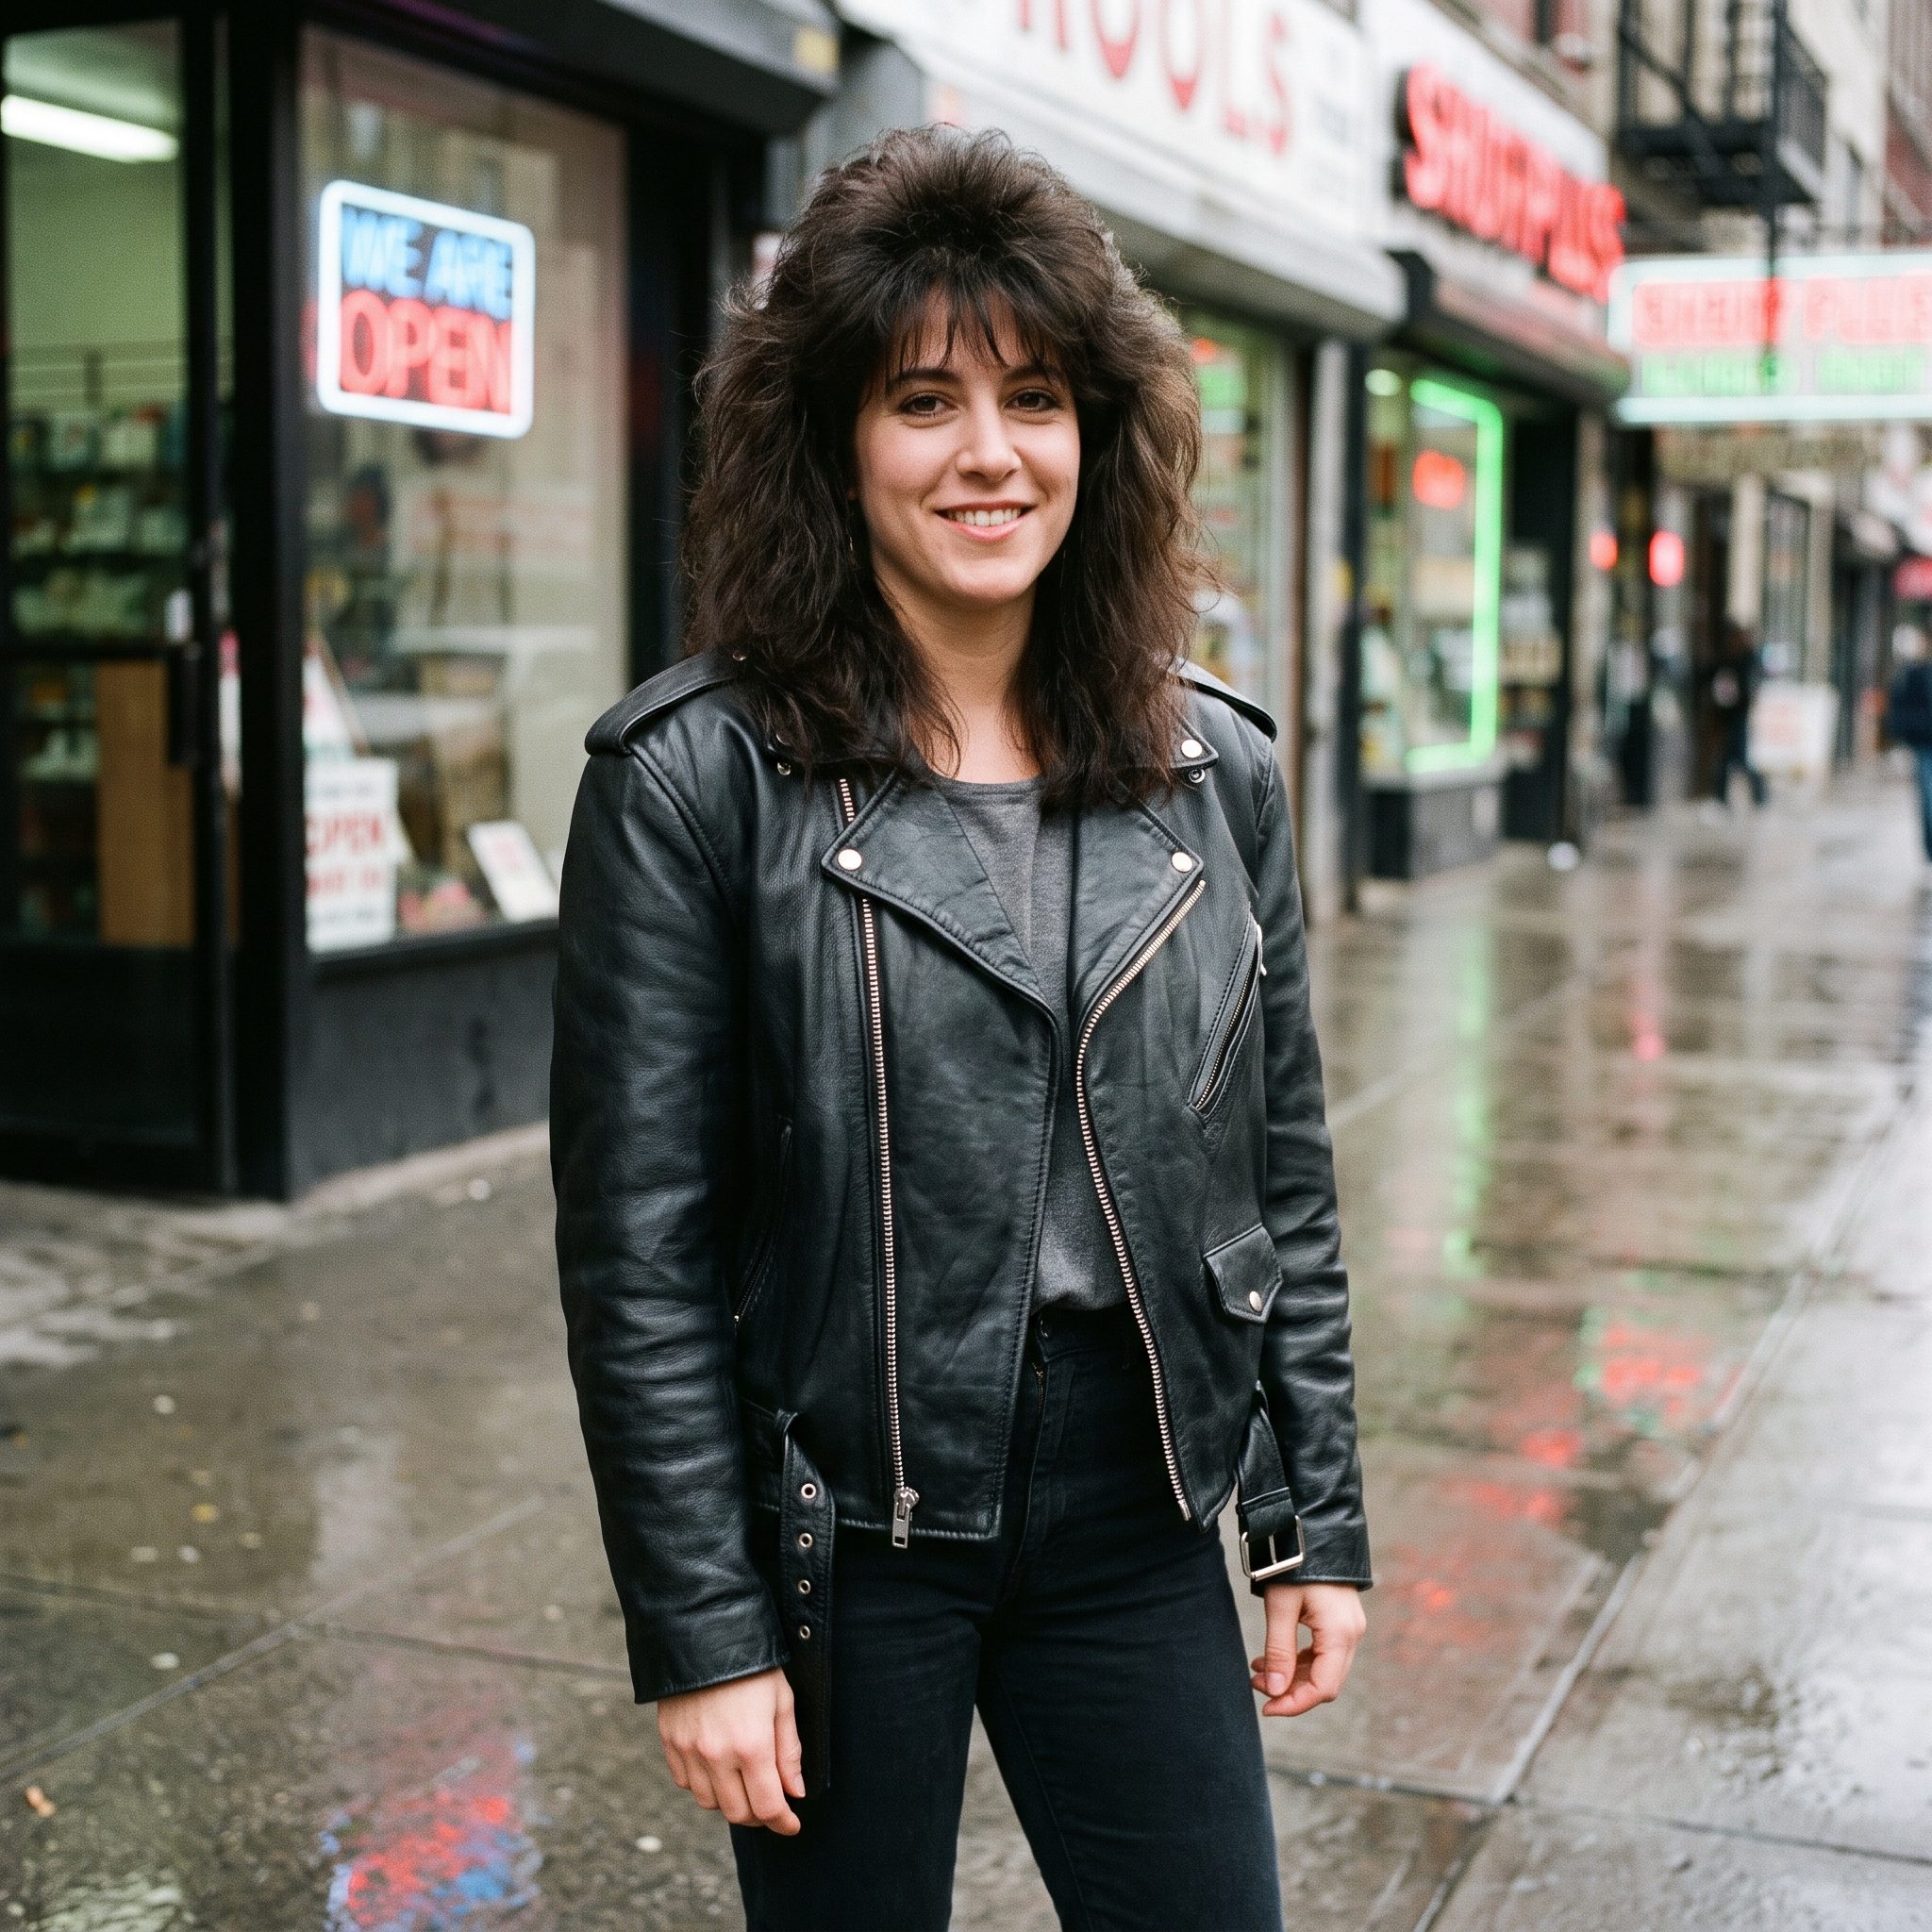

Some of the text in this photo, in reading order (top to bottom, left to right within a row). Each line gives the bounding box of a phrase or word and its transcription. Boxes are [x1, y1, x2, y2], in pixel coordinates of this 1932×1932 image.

[341, 205, 512, 321] WE ARE
[341, 289, 512, 415] OPEN
